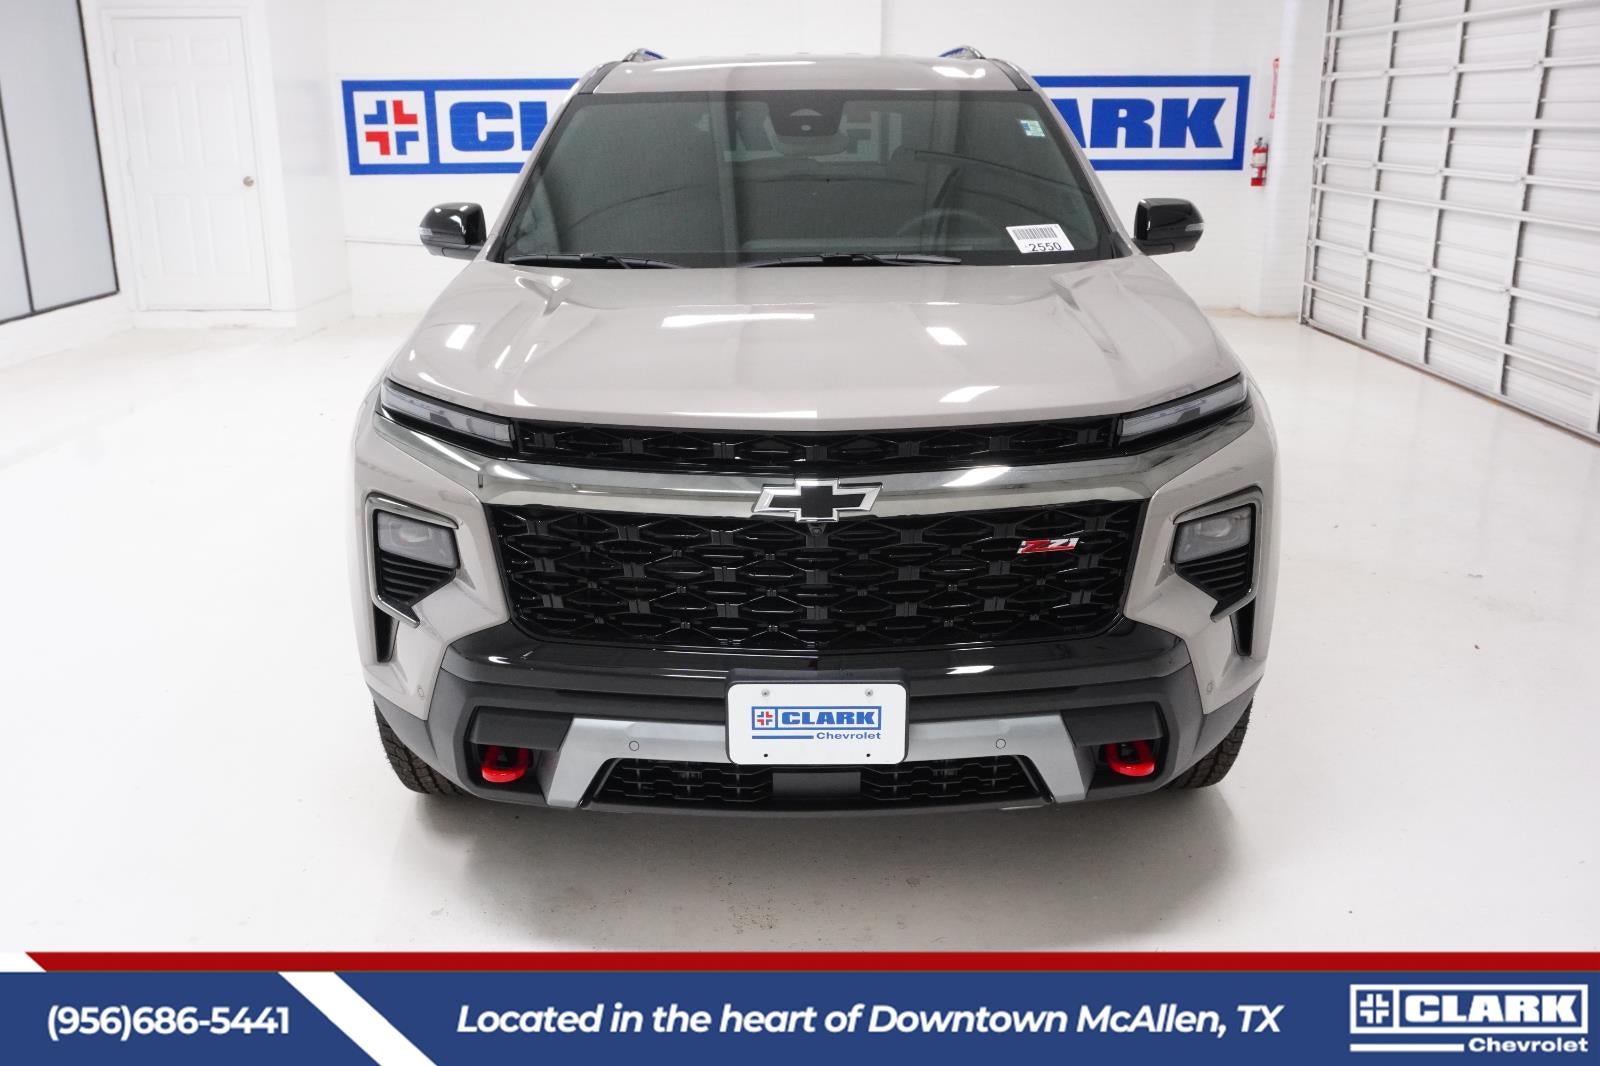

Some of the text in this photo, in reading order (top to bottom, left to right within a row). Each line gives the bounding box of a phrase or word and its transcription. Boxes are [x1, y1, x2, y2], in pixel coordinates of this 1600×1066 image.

[1028, 242, 1062, 252] 2550
[781, 711, 876, 725] CLARK
[816, 731, 881, 740] Chevrolet
